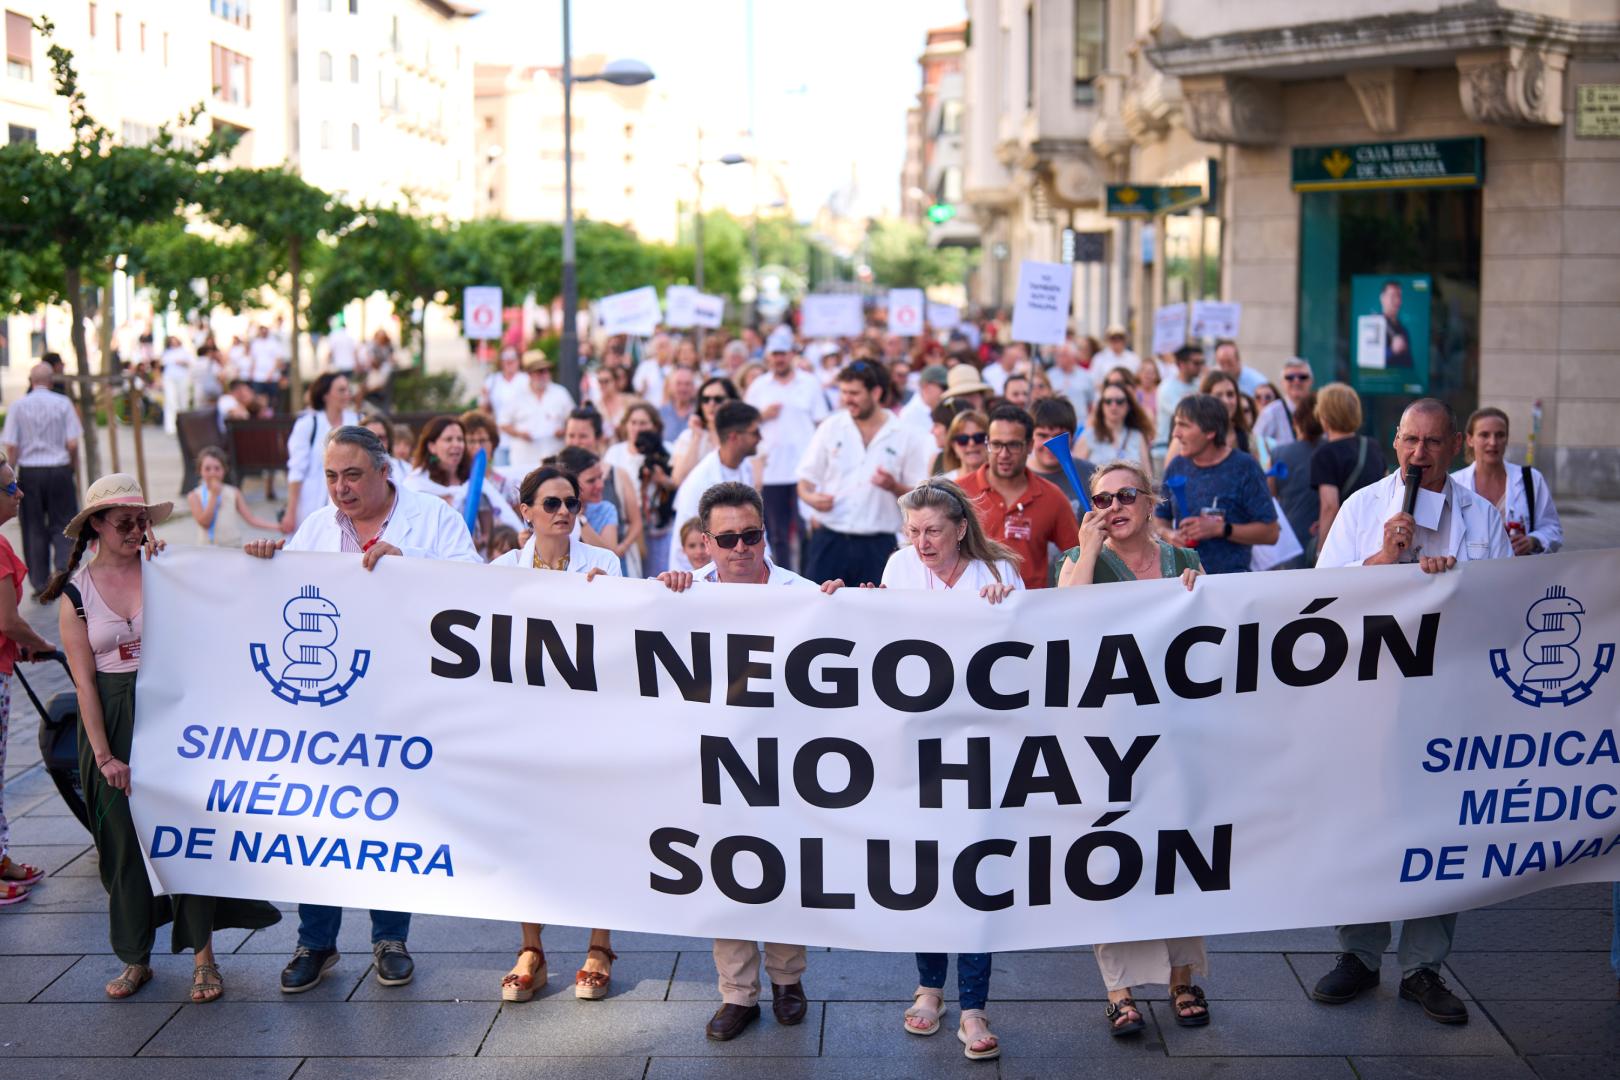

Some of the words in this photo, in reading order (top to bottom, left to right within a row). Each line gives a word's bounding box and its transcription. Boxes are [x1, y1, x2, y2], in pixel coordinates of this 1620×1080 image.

[1356, 163, 1376, 178] DE
[1380, 160, 1448, 177] NAVARRA
[430, 609, 598, 692] SIN
[634, 597, 1442, 713] NEGOCIACIÓN
[177, 725, 434, 770] SINDICATO
[1421, 729, 1620, 773] SINDICA
[700, 734, 875, 809] NO
[919, 734, 1161, 810] HAY
[206, 774, 400, 821] MÉDICO
[1458, 779, 1618, 826] MÉDIC
[149, 826, 216, 860] DE
[229, 831, 454, 877] NAVARRA
[649, 810, 1233, 912] SOLUCIÓN
[1399, 845, 1469, 883] DE
